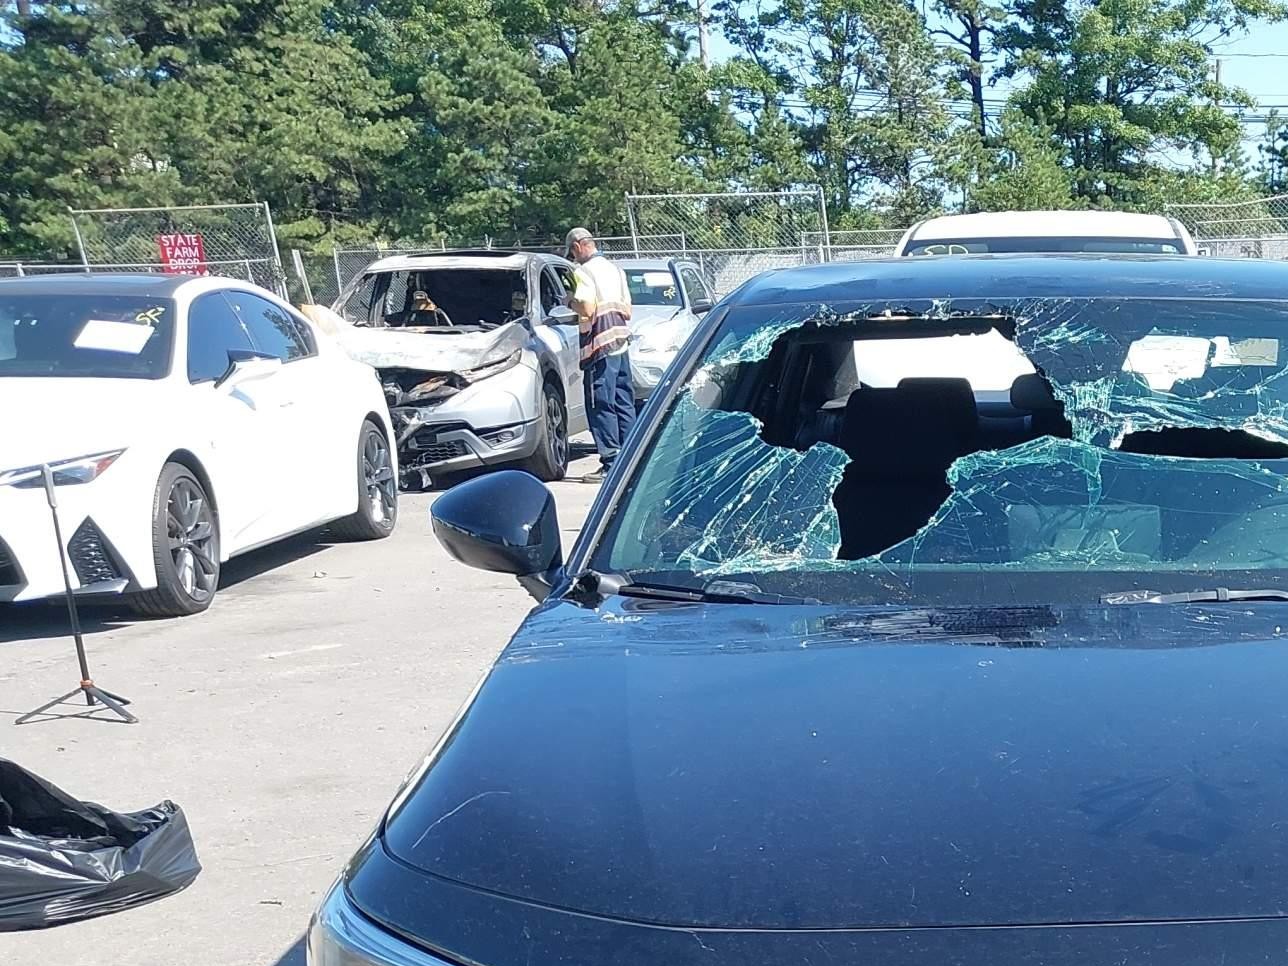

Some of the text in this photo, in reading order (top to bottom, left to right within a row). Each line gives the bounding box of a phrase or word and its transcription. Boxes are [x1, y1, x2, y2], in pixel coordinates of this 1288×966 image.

[161, 234, 199, 246] STATE
[166, 246, 200, 258] FARM
[169, 259, 200, 270] DROP
